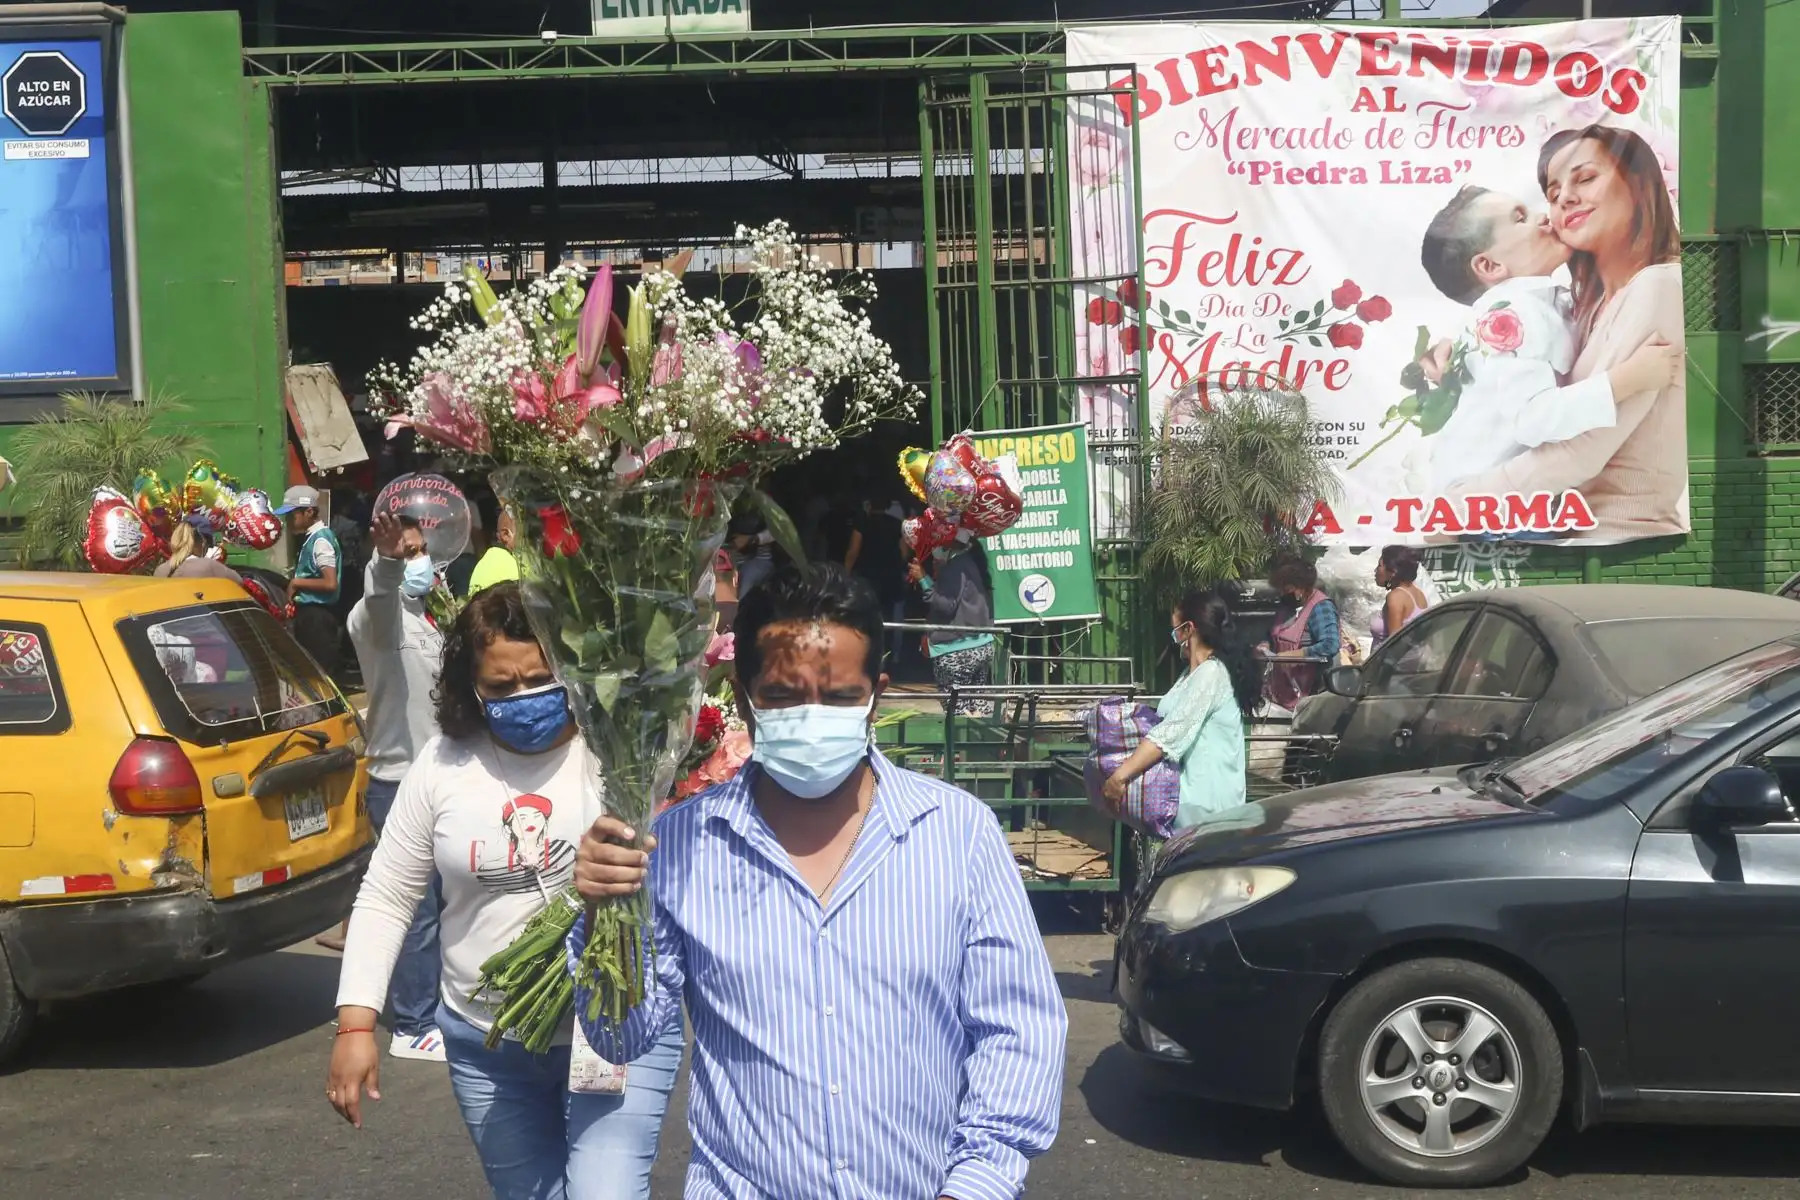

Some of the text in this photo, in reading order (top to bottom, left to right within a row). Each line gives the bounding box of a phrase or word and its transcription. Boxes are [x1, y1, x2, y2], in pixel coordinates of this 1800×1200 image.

[18, 81, 71, 92] ALTO EN
[1109, 32, 1647, 127] BIENVENIDOS
[18, 93, 71, 107] AZÚCAR
[1350, 86, 1406, 113] AL
[1174, 101, 1525, 161] Mercado de Flores
[28, 150, 66, 158] EXCESIVO
[47, 141, 86, 149] CONSUMO
[1142, 208, 1312, 287] Feliz
[1198, 292, 1293, 318] Día De
[1229, 323, 1270, 354] La
[1140, 331, 1352, 412] Madre
[1317, 422, 1345, 432] CON
[1348, 422, 1366, 431] SU
[975, 432, 1076, 466] INGRESO
[1337, 435, 1360, 446] DEL
[1022, 468, 1061, 486] DOBLE
[1385, 493, 1597, 533] TARMA
[987, 527, 1081, 552] DE VACUNACIÓN
[996, 551, 1074, 571] OBLIGATORIO
